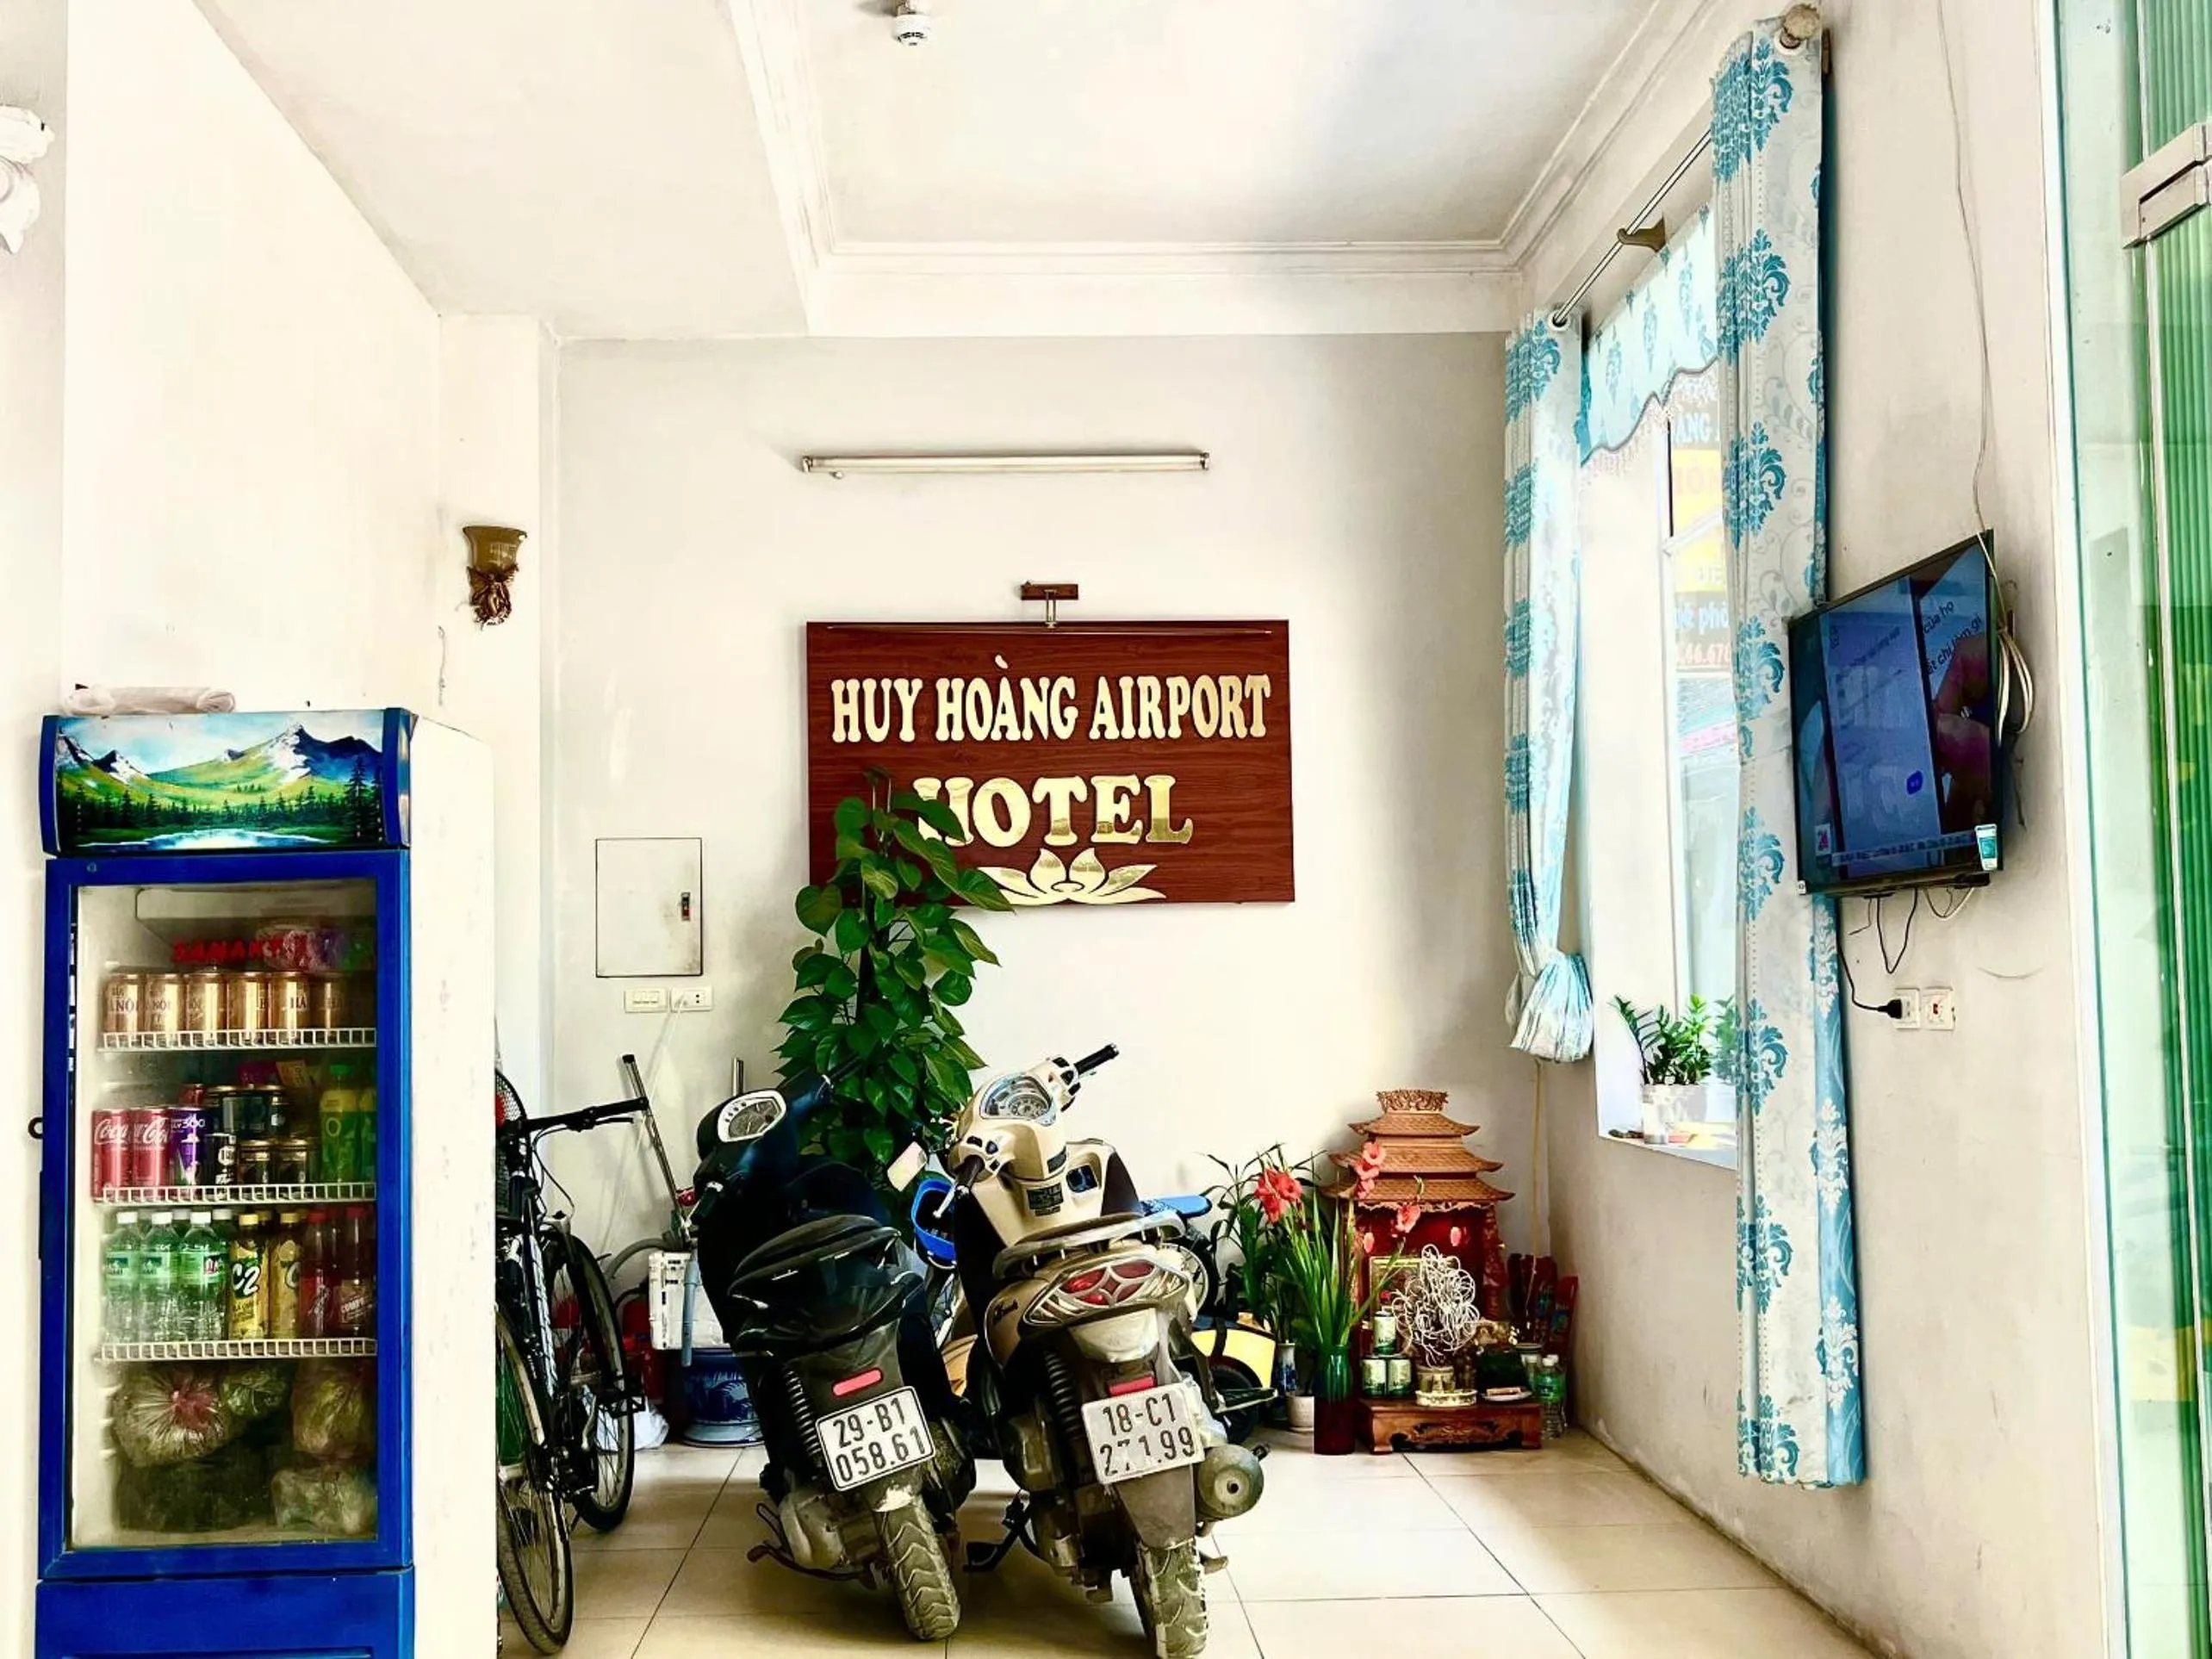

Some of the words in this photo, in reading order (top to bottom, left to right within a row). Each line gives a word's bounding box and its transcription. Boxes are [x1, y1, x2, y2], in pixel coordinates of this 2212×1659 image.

[831, 678, 923, 743] HUY
[935, 654, 1079, 742] HOÀNG
[1089, 674, 1272, 740] AIRPORT
[232, 1263, 260, 1296] C2
[833, 1397, 906, 1451] 29-B1
[1102, 1393, 1177, 1437] 18-C1
[835, 1425, 927, 1482] 058.61
